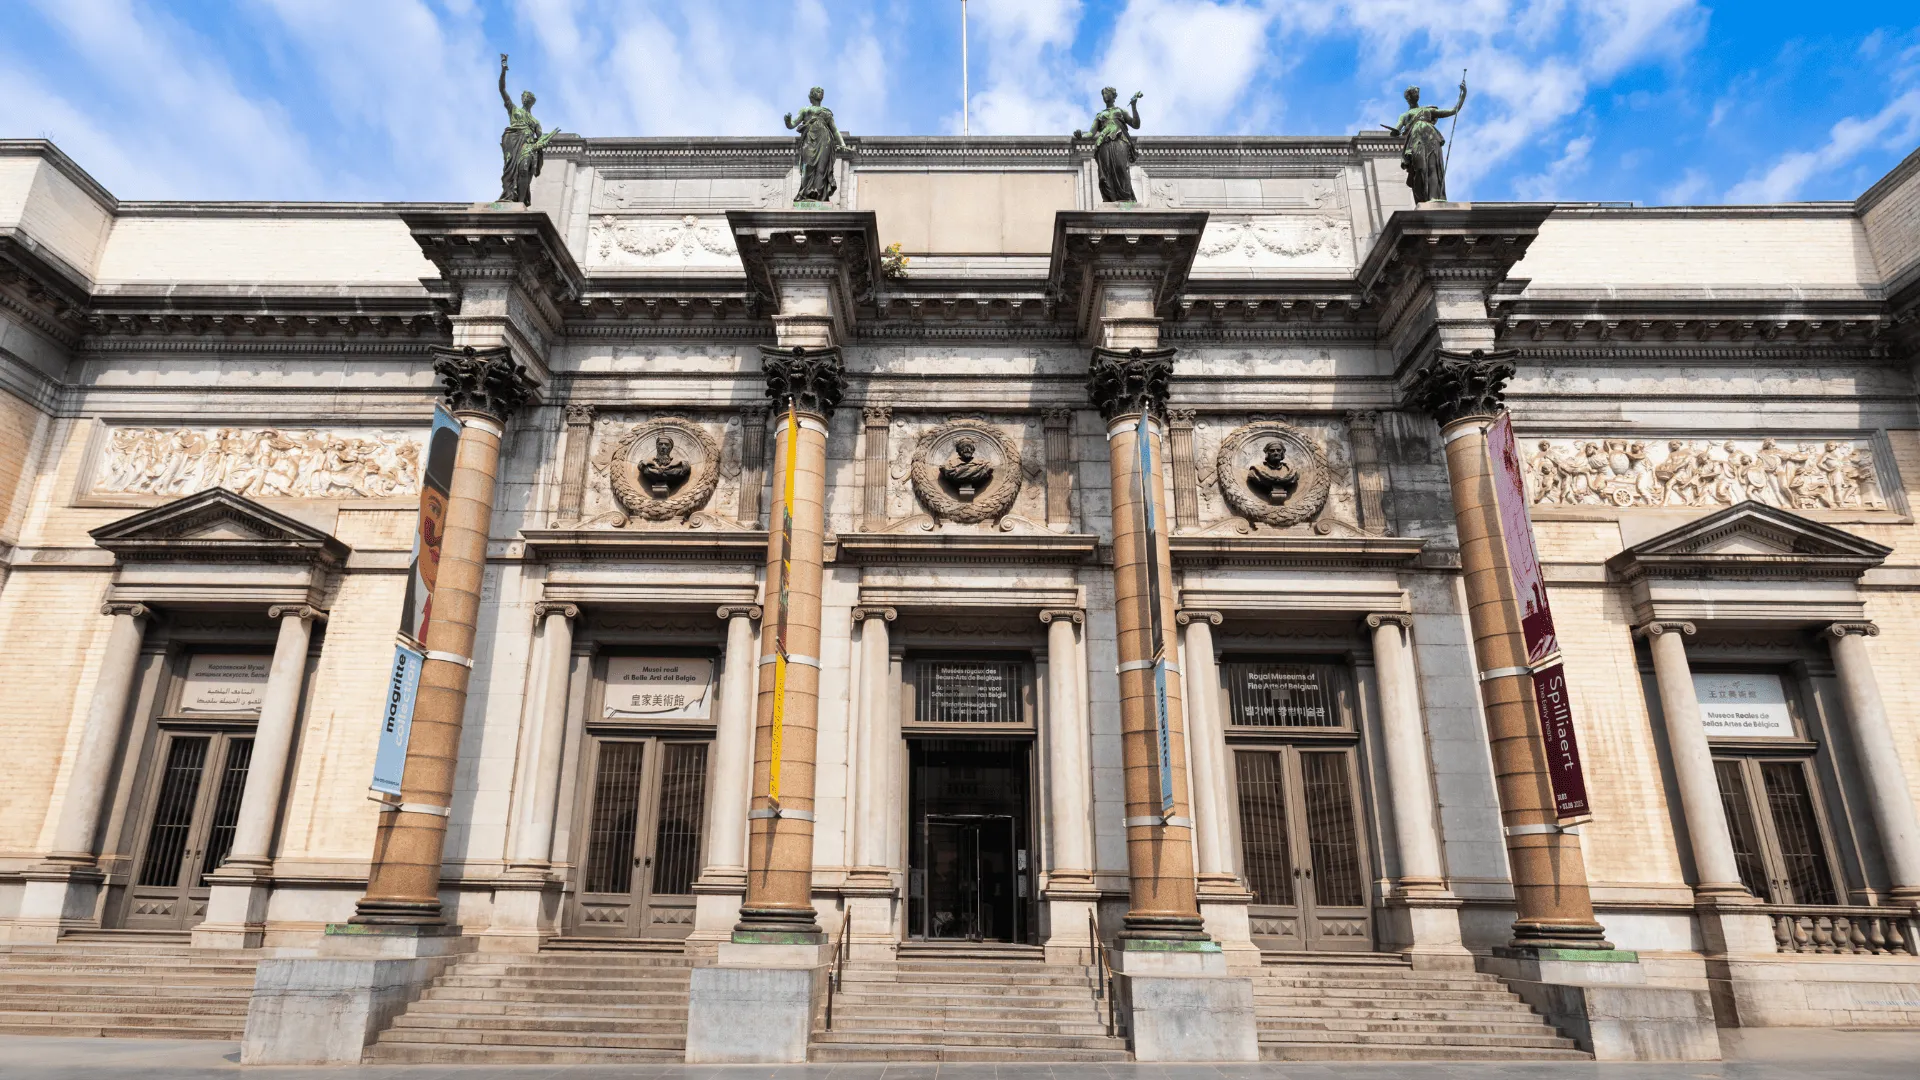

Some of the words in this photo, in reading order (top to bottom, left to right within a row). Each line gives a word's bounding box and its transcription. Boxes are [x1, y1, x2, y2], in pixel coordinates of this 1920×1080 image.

[675, 674, 696, 682] Belgio
[976, 674, 1002, 682] Belgique
[1248, 672, 1270, 681] Royal
[1247, 682, 1263, 690] Fine
[1263, 682, 1279, 690] Arts
[1279, 682, 1287, 690] of
[1288, 683, 1319, 692] Belgium
[386, 653, 406, 733] magritte
[396, 659, 417, 747] collection
[631, 694, 685, 707] 皇家美術館
[1245, 706, 1275, 717] 벨기에
[1547, 675, 1575, 771] Spilliaert
[1753, 721, 1780, 729] Bélgica
